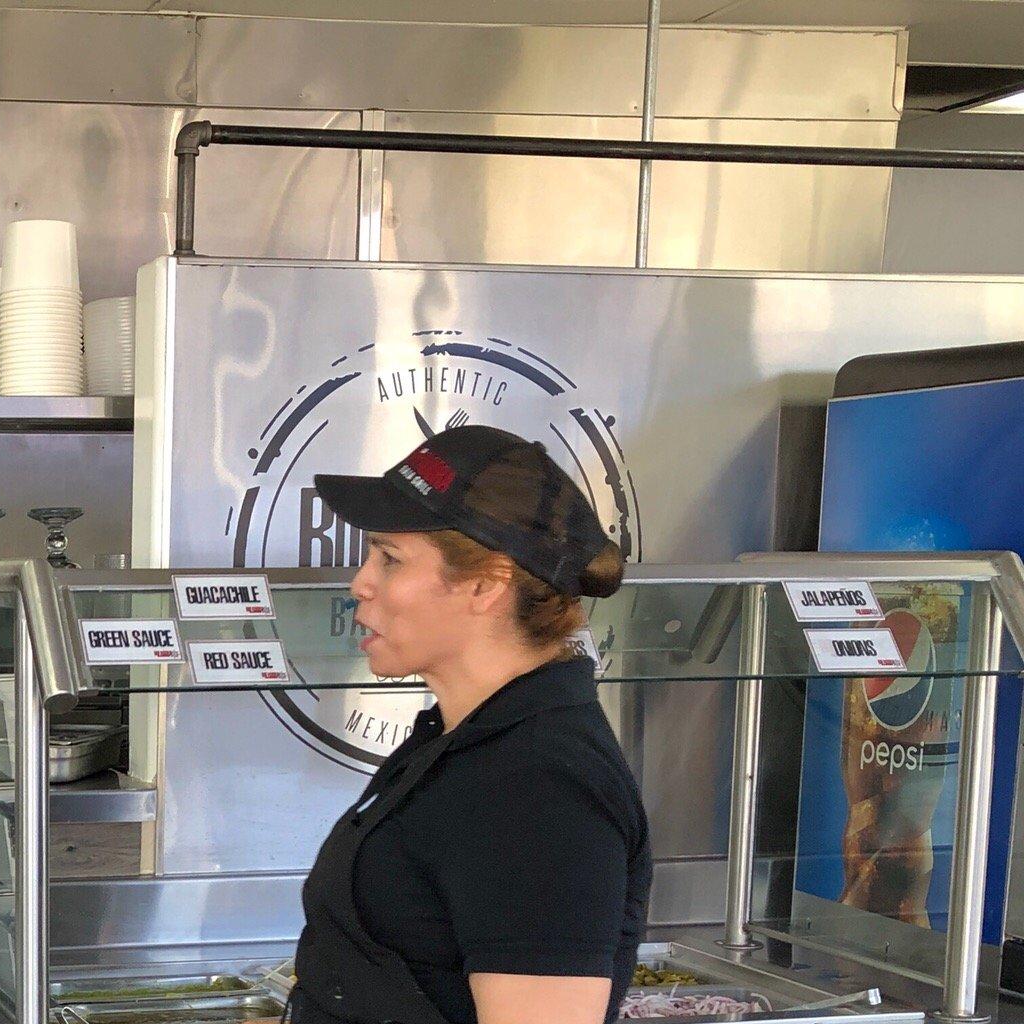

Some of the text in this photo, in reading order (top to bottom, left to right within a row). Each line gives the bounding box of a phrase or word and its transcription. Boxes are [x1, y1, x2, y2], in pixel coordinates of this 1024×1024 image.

[377, 366, 508, 406] AUTHENTIC
[185, 585, 261, 604] GUACACHILE
[801, 588, 867, 607] JALAPEÑOS
[88, 630, 174, 649] GREEN SAUCE
[832, 640, 877, 657] ONIONS
[203, 651, 273, 670] RED SAUCE
[345, 709, 414, 746] MEXIC
[860, 740, 925, 775] pepsi
